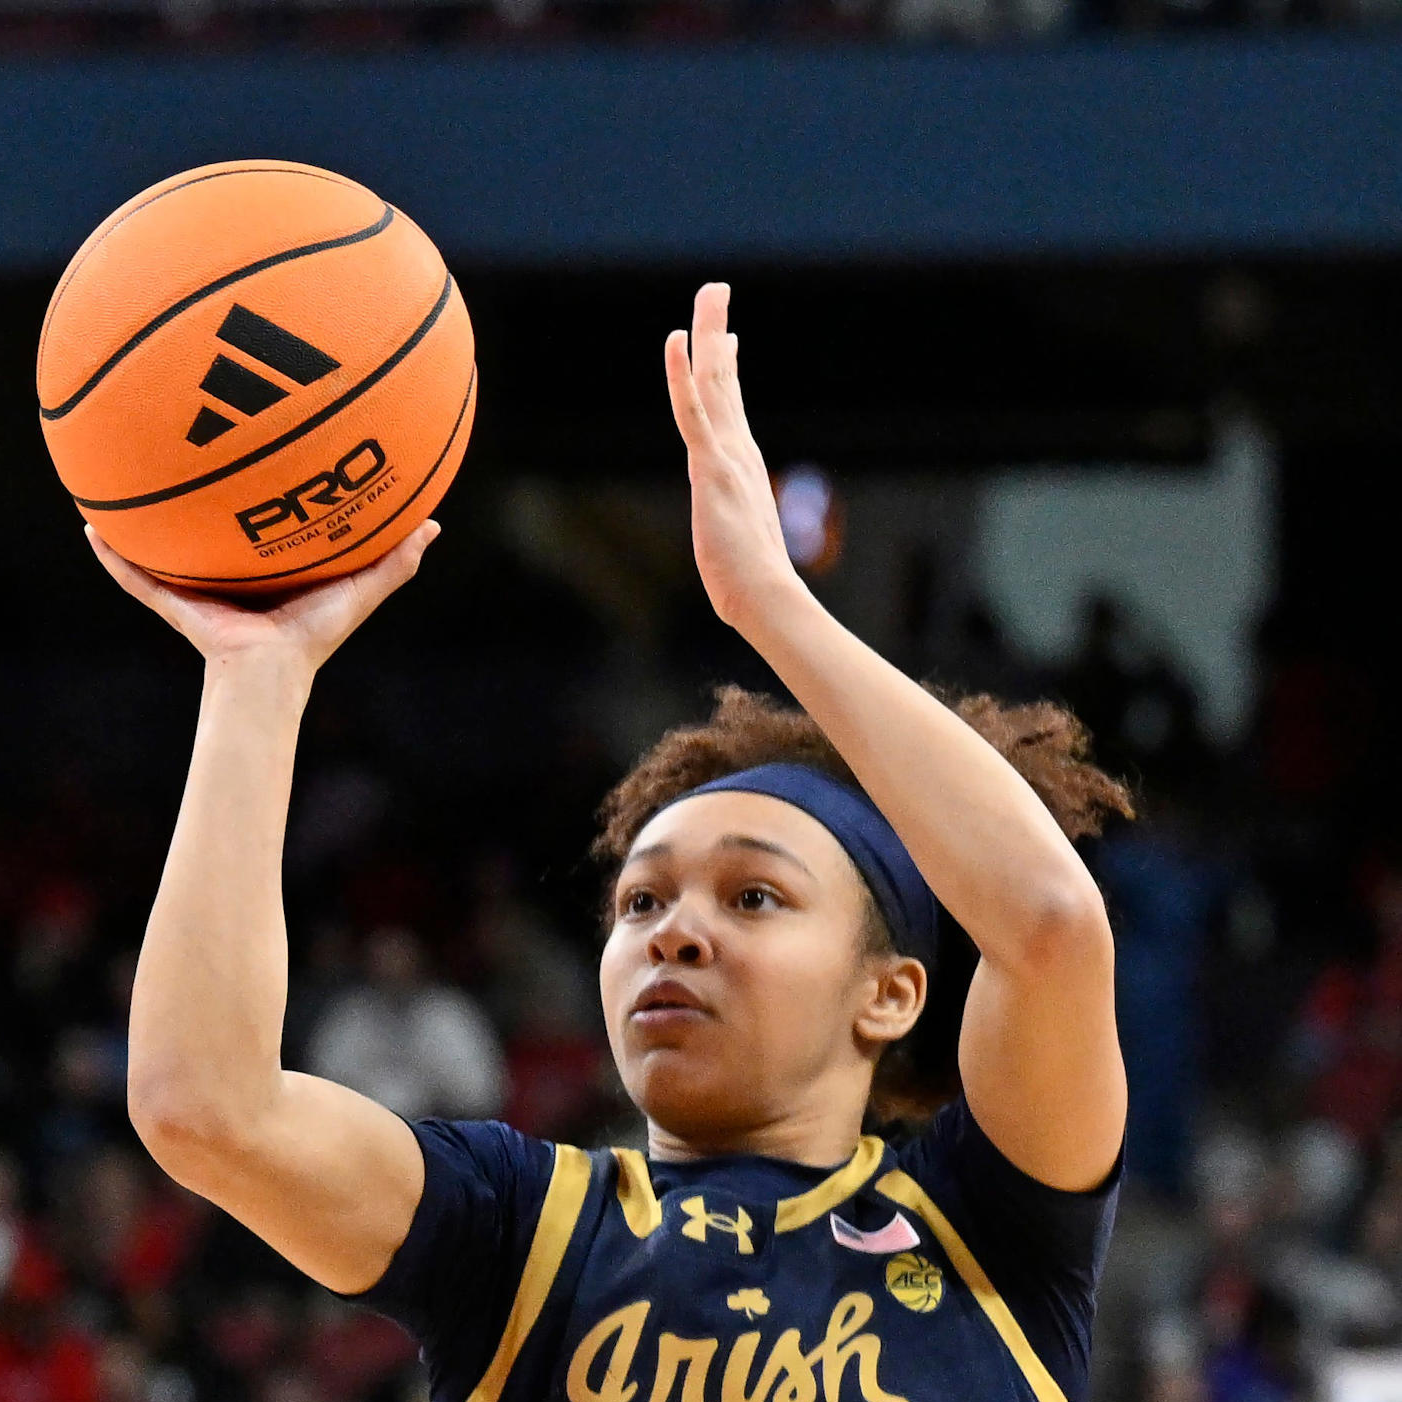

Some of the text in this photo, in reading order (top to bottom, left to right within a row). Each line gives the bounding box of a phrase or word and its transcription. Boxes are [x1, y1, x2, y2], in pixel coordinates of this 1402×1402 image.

[234, 438, 386, 543] PRO
[258, 528, 323, 558] OFFICIAL
[326, 501, 364, 529] GAME
[366, 475, 398, 503] BALL
